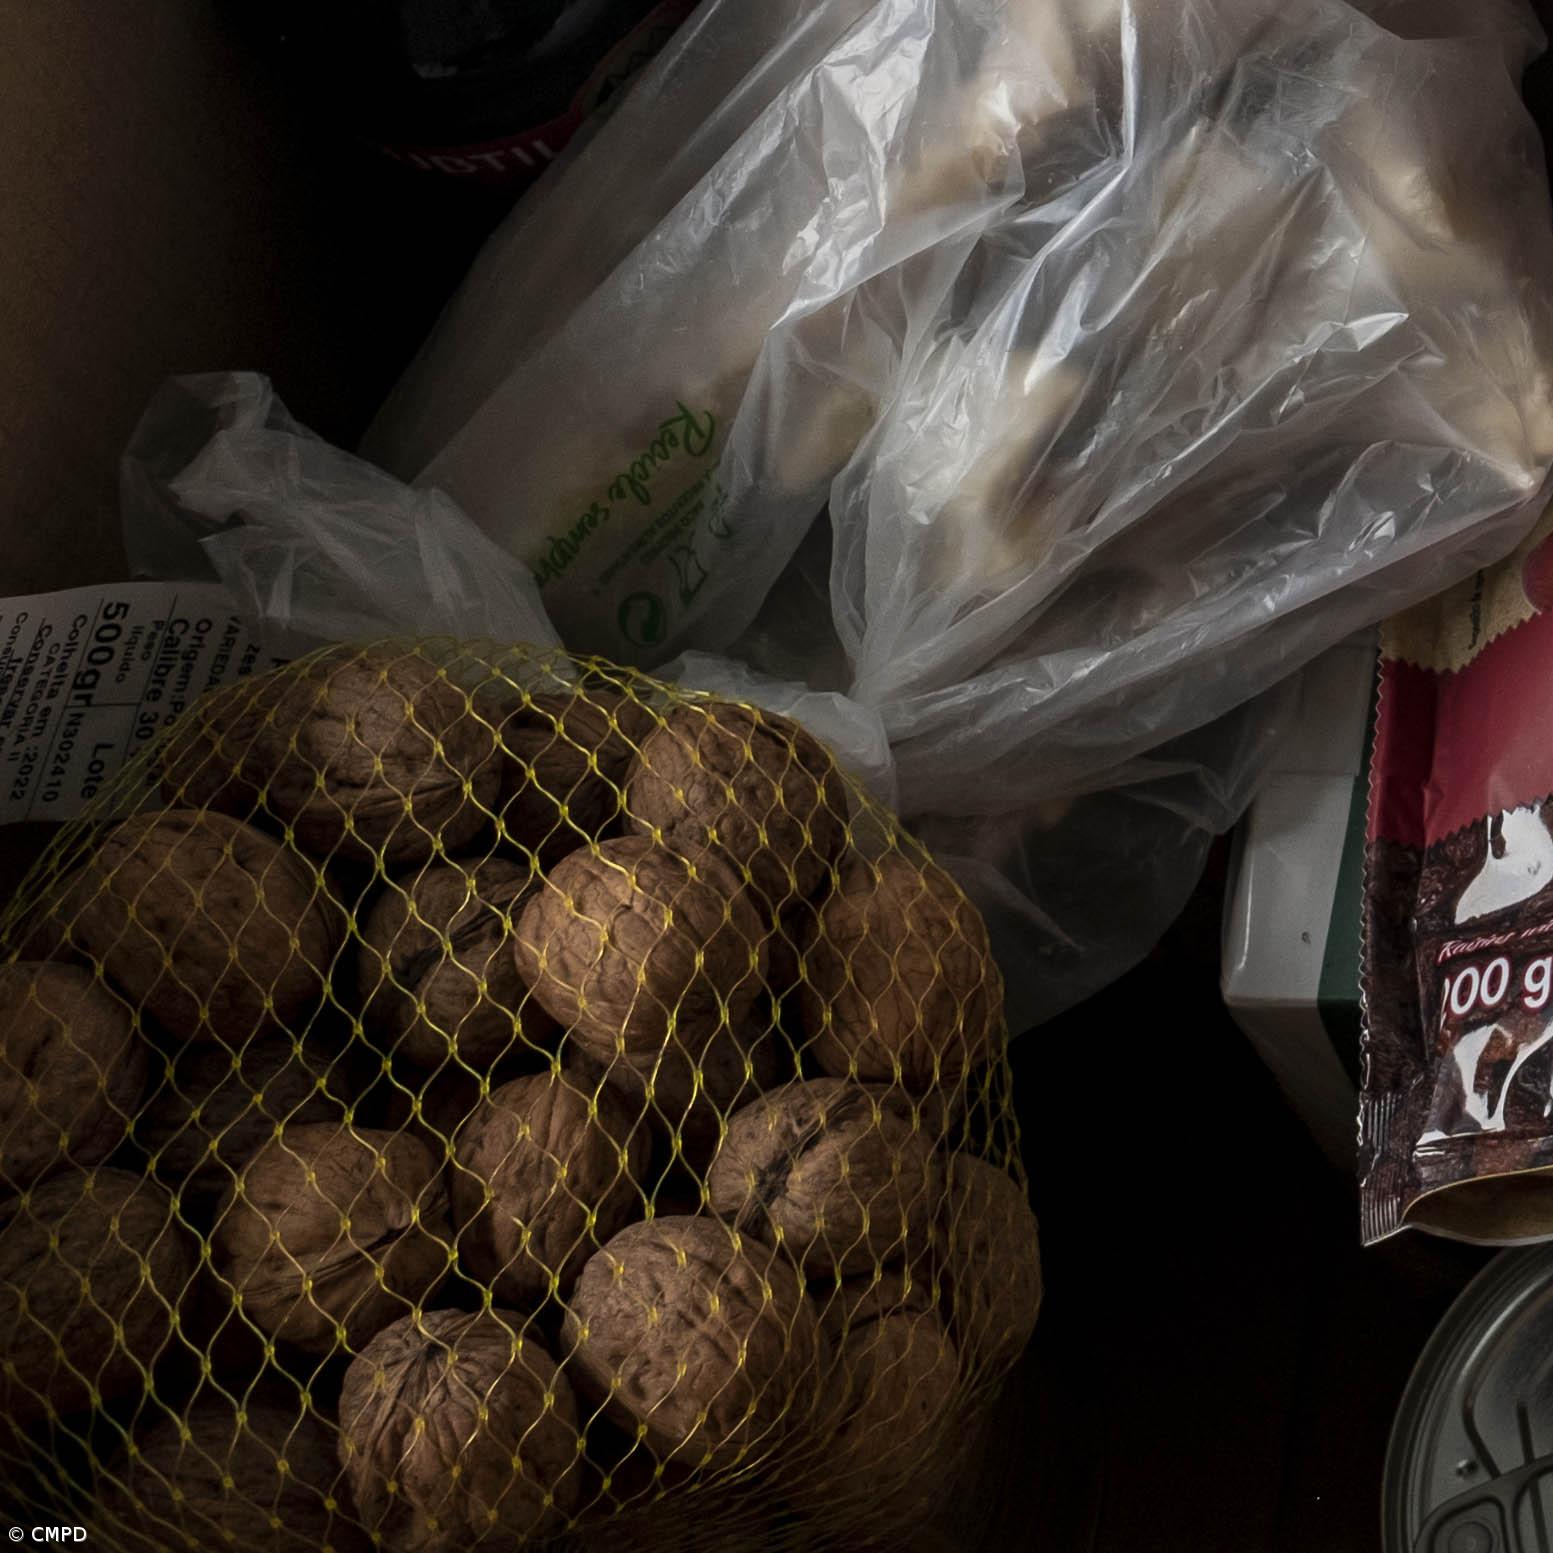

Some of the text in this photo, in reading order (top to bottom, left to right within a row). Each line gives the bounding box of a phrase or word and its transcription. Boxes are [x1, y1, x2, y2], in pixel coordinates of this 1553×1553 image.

[608, 399, 715, 506] Recicle
[43, 613, 88, 700] Colheita
[74, 601, 130, 708] 500gr
[141, 619, 167, 662] Peso
[146, 617, 190, 702] Calibre
[41, 711, 84, 803] N302410
[80, 742, 113, 799] Lote
